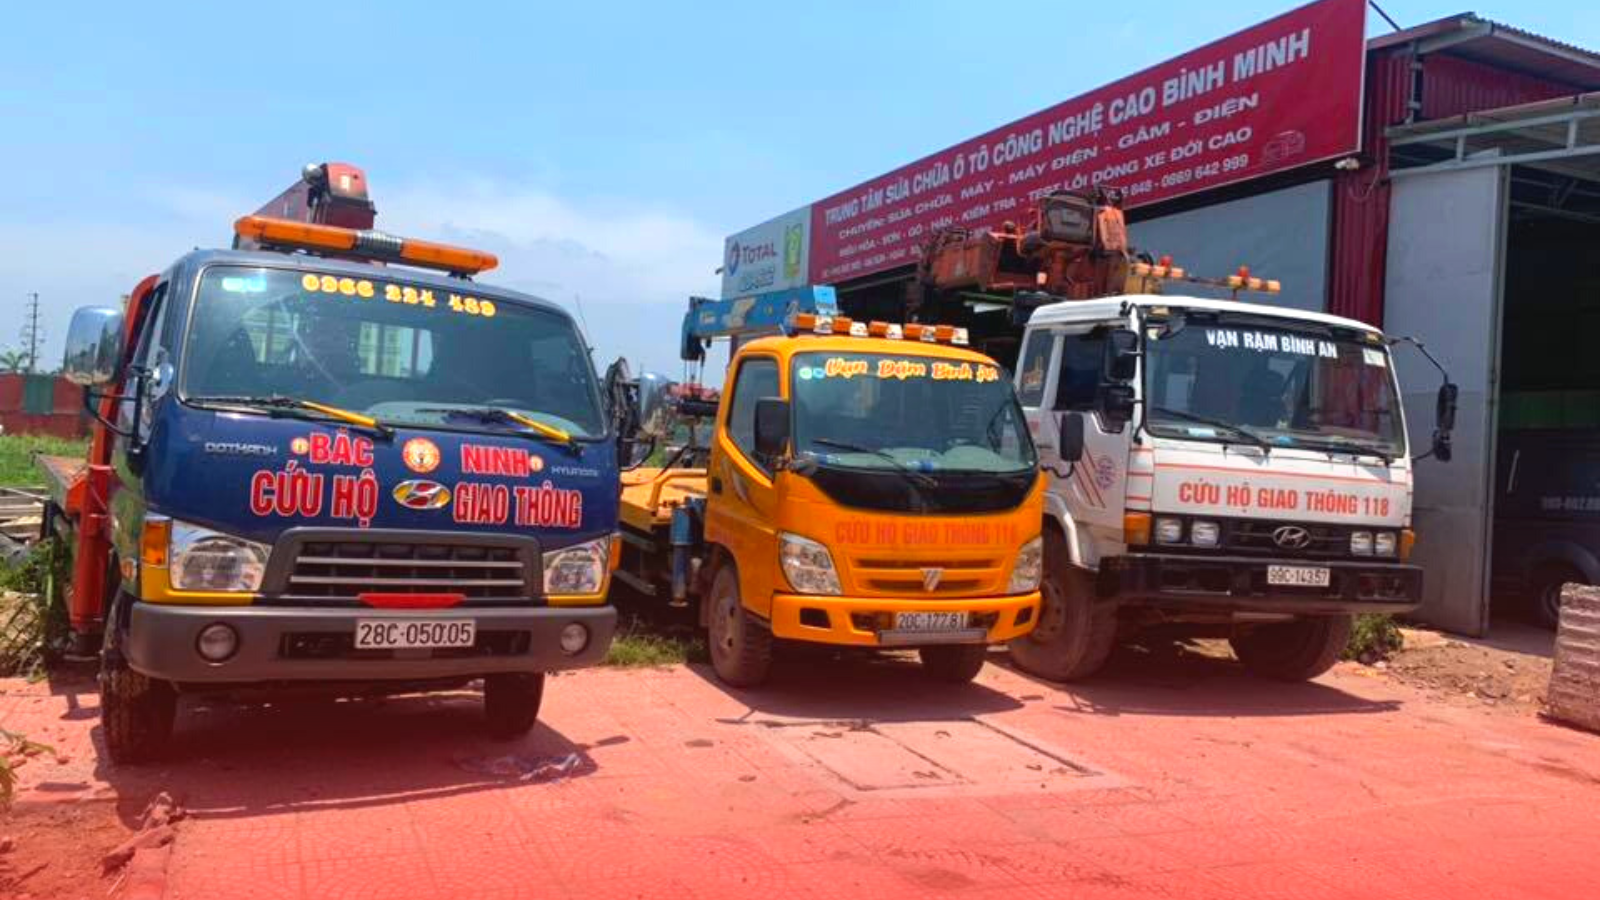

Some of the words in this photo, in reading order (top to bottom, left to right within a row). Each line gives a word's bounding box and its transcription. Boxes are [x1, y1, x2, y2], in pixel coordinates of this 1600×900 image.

[826, 198, 859, 226] TRUNG
[953, 152, 965, 179] Ô
[968, 144, 989, 174] TÔ
[993, 129, 1042, 166] CÔNG
[1048, 103, 1104, 147] NGHỆ
[1108, 86, 1156, 126] CAO
[1162, 60, 1225, 107] BÌNH
[1232, 27, 1310, 83] MINH
[1051, 146, 1098, 171] ĐIỆN
[1193, 92, 1259, 126] ĐIỆN
[1092, 159, 1139, 185] DÒNG
[1144, 151, 1167, 170] XE
[1208, 127, 1252, 150] CAO
[1223, 154, 1249, 172] 999
[1206, 329, 1239, 349] VẠN
[1281, 333, 1315, 356] BÌNH
[1318, 340, 1338, 359] AN
[310, 426, 374, 467] BẮC
[460, 443, 530, 477] NINH
[250, 459, 325, 517] CỨU
[331, 467, 379, 528] HỘ
[453, 481, 509, 525] GIAO
[513, 479, 583, 528] THÔNG
[1178, 477, 1220, 505] CỨU
[1226, 480, 1251, 514] HỘ
[1257, 487, 1298, 510] GIAO
[1306, 488, 1358, 515] THÔNG
[1363, 496, 1389, 517] 118
[904, 521, 939, 544] GIAO
